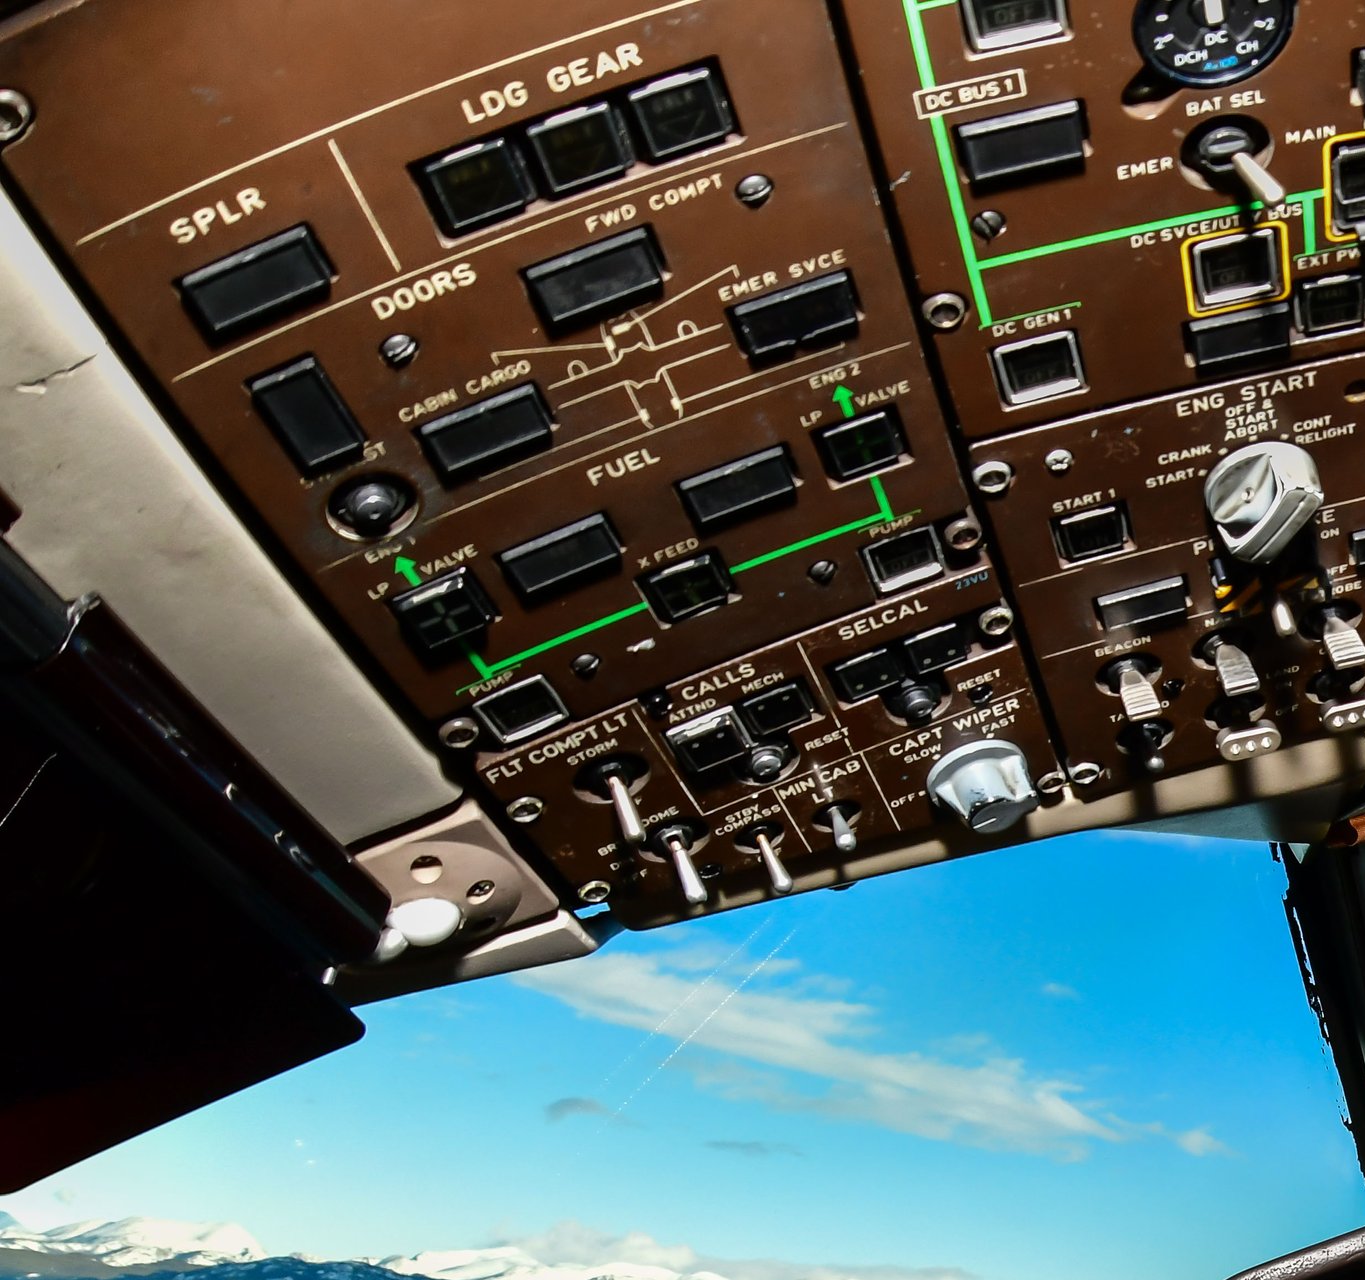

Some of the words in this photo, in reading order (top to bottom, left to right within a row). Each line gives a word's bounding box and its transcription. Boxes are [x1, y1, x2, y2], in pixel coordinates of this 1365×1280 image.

[461, 81, 529, 124] LDG
[546, 42, 643, 94] GEAR
[925, 89, 951, 109] DC
[955, 81, 1000, 103] BUS
[1005, 78, 1015, 95] 1
[1186, 97, 1223, 116] BAT
[1229, 91, 1266, 108] SEL
[1285, 124, 1336, 145] MAIN
[1117, 157, 1174, 179] EMER
[169, 188, 267, 245] SPLR
[584, 206, 636, 233] FWD
[649, 174, 724, 211] COMPT
[717, 271, 778, 302] EMER
[788, 249, 847, 278] SVCE
[371, 264, 477, 319] DOORS
[398, 390, 459, 422] CABIN
[466, 361, 531, 394] CARGO
[800, 410, 822, 428] LP
[854, 381, 911, 407] VALVE
[1176, 393, 1225, 418] ENG
[1240, 371, 1318, 403] START
[1224, 420, 1278, 441] ABORT
[1225, 409, 1275, 429] START
[1293, 415, 1333, 432] CONT
[1295, 423, 1356, 444] RELIGHT
[586, 448, 660, 486] FUEL
[1157, 444, 1212, 465] CRANK
[1146, 468, 1195, 488] START
[838, 599, 928, 641] SELCAL
[1095, 635, 1152, 657] BEACON
[681, 663, 756, 701] CALLS
[741, 672, 785, 695] MECH
[957, 669, 1002, 693] RESET
[889, 727, 943, 756] CAPT
[952, 698, 1020, 734] WIPER
[981, 715, 1016, 735] FAST
[486, 758, 524, 783] FLT
[527, 726, 599, 766] COMPT
[603, 714, 628, 736] LT
[567, 739, 618, 766] STORM
[903, 744, 942, 765] SLOW
[779, 776, 814, 801] MIN
[819, 761, 862, 783] CAB
